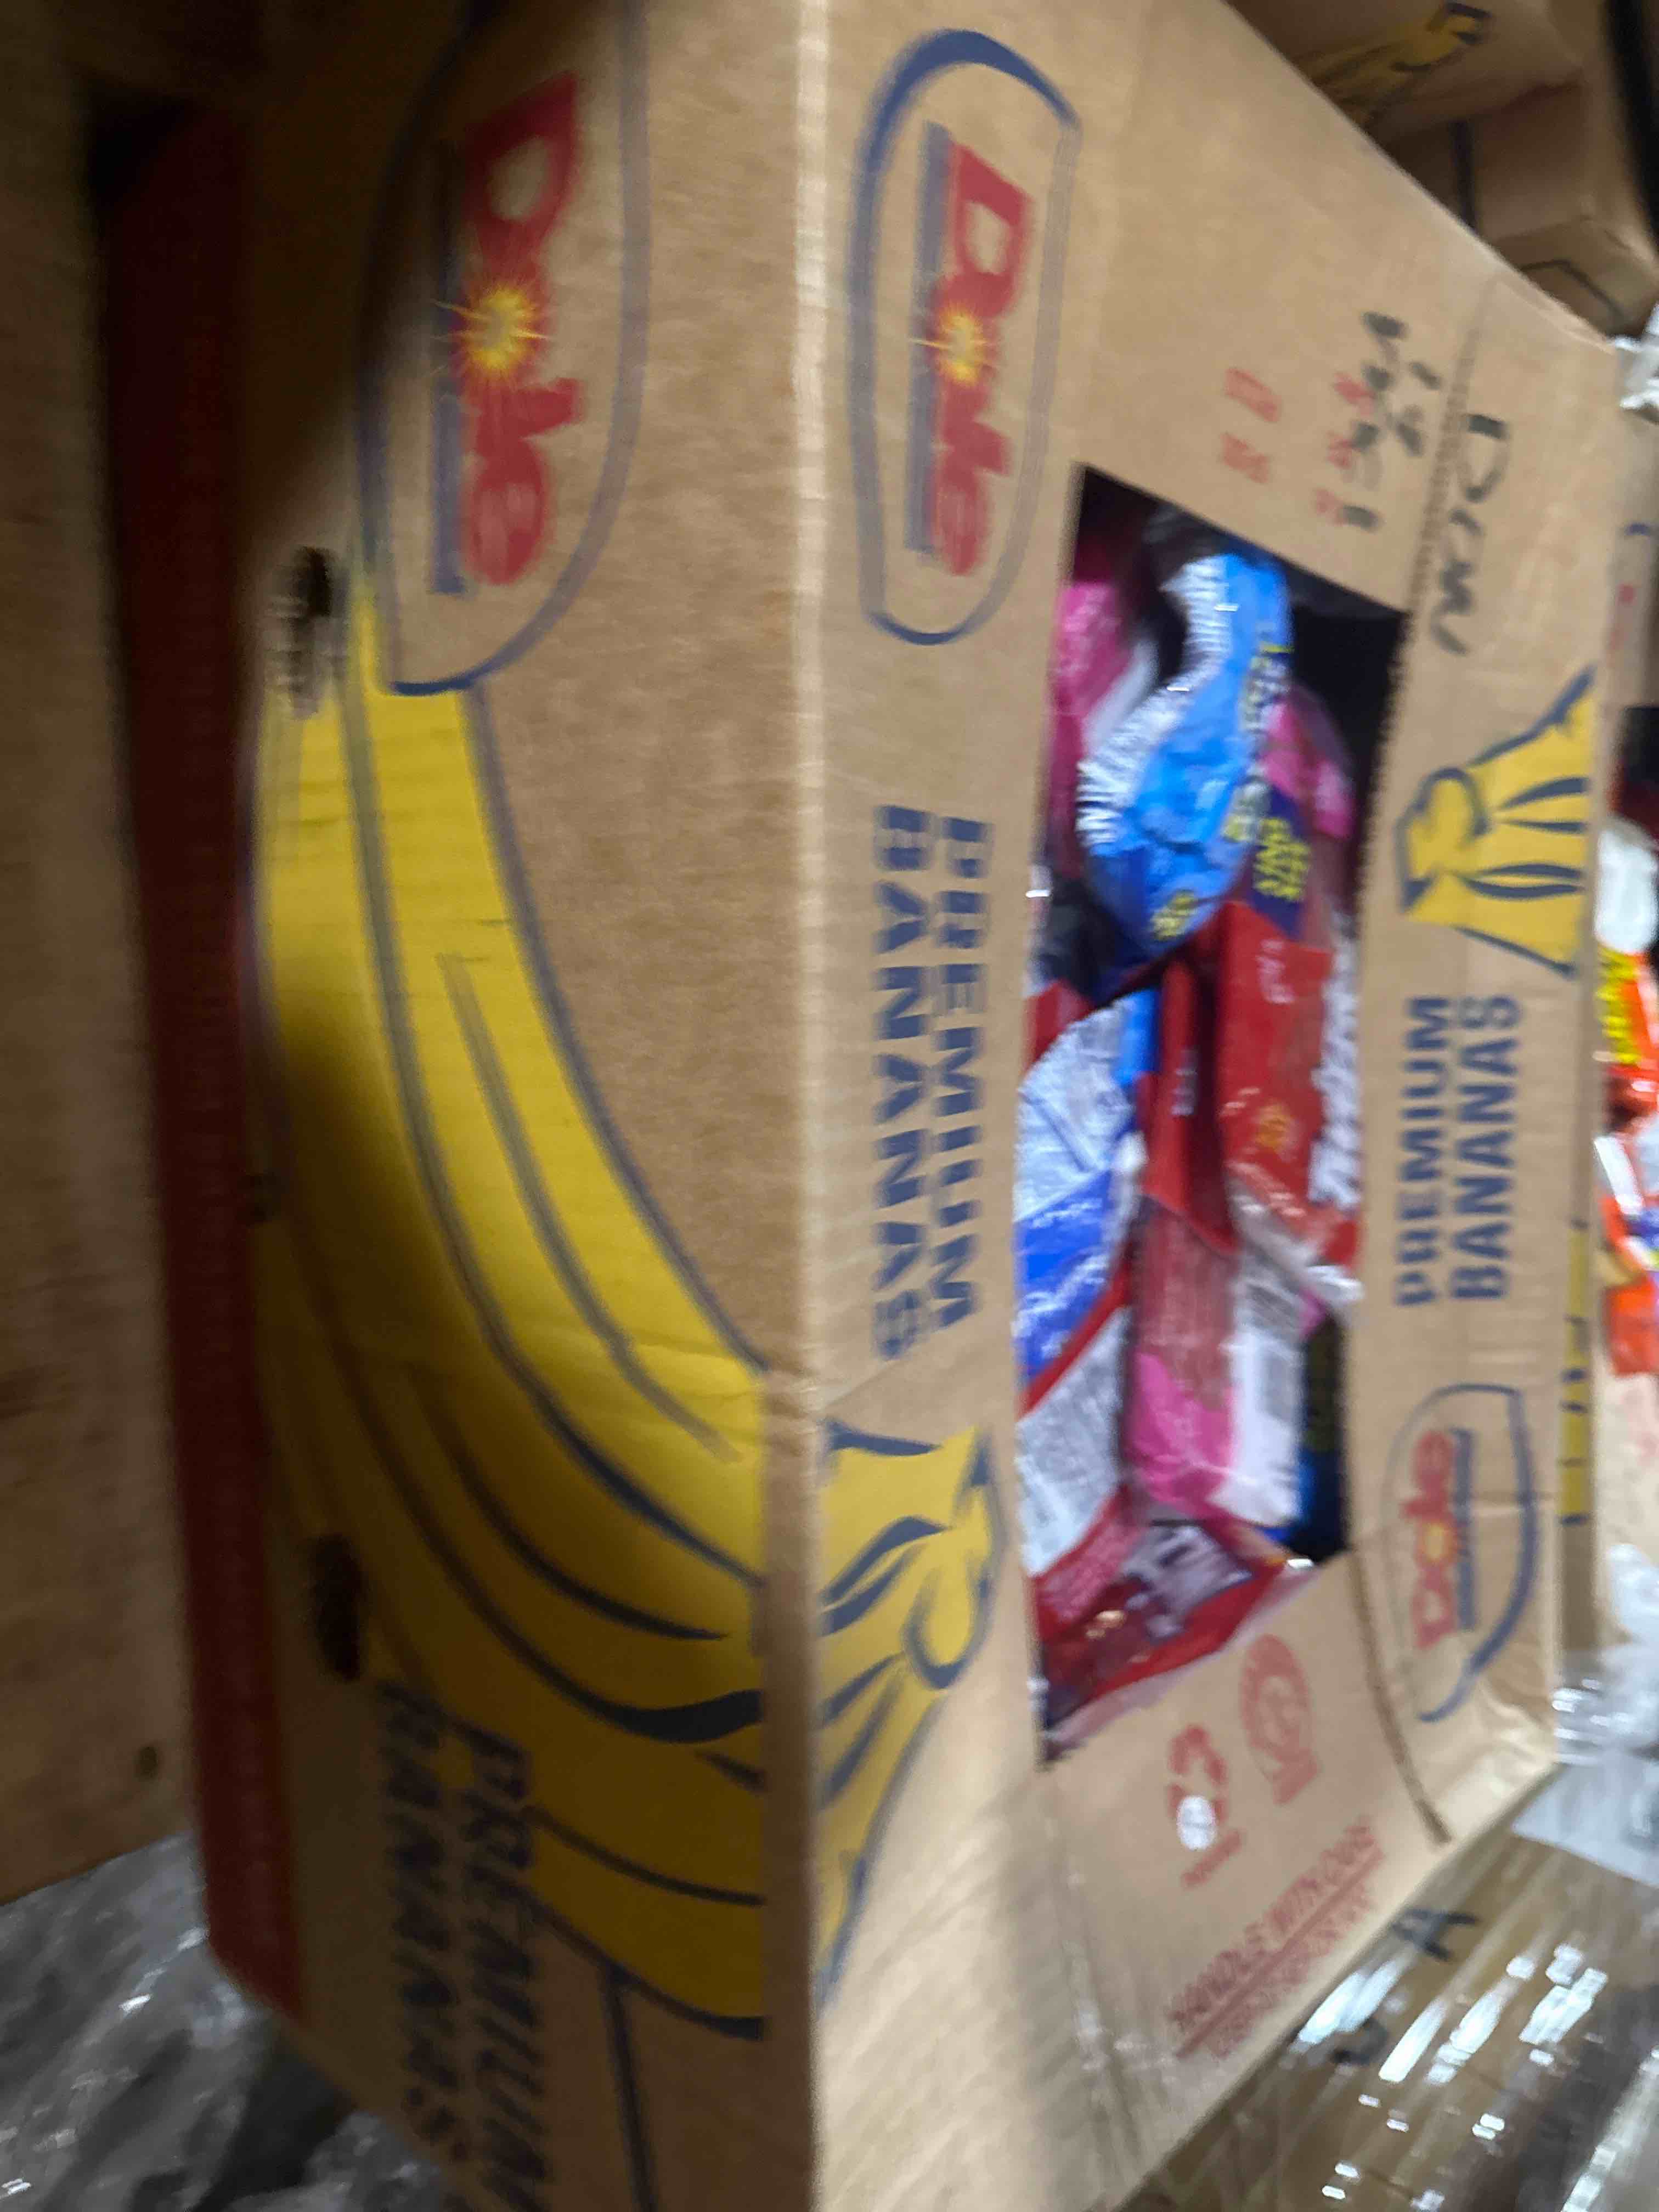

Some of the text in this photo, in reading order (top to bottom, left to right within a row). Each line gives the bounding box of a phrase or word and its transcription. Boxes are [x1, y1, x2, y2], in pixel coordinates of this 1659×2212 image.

[461, 69, 582, 586] Dole
[927, 140, 1032, 577] Dole
[873, 804, 931, 1363] BANANAS
[932, 813, 993, 1332] PREMIUM
[1396, 996, 1449, 1307] PREMIUM
[1451, 994, 1524, 1300] BANANAS
[1400, 1429, 1458, 1650] Dole
